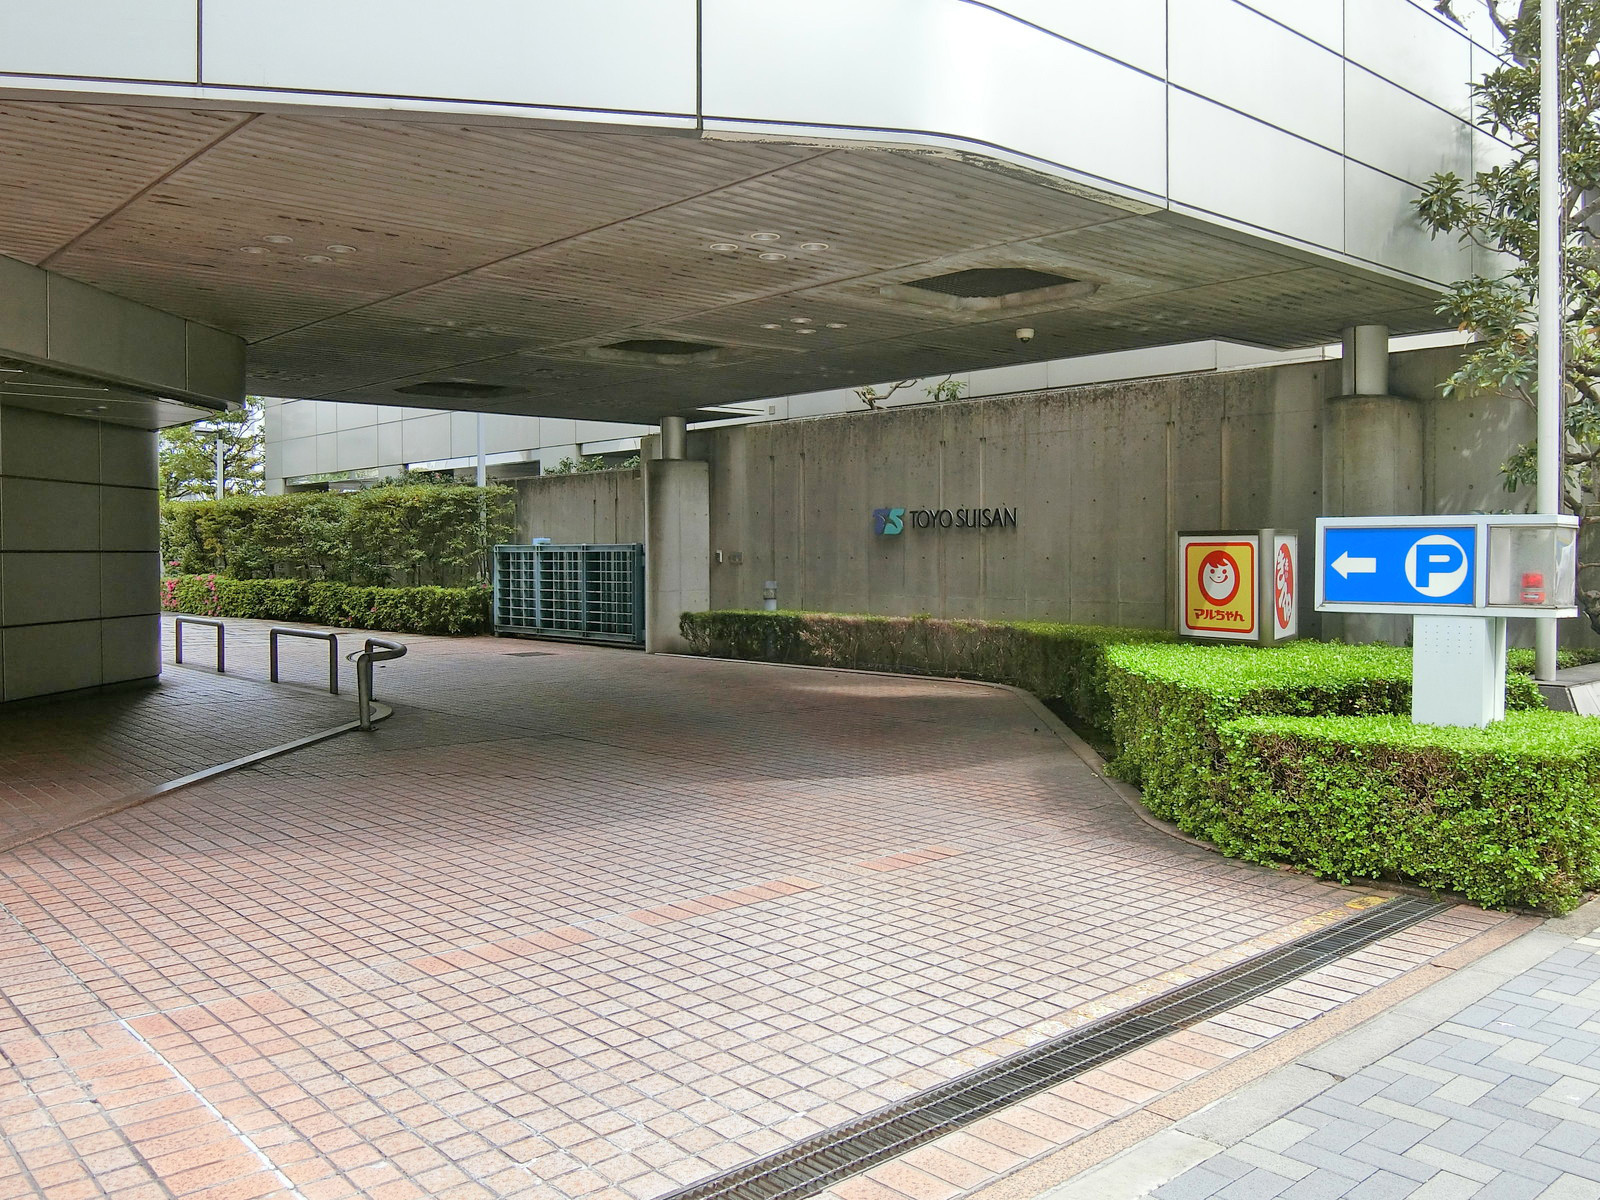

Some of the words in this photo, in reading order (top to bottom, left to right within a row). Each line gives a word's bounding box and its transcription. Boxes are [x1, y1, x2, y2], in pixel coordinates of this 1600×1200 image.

[910, 510, 953, 528] TOYO
[956, 507, 1018, 528] SUISAN
[1416, 544, 1463, 588] P
[1193, 608, 1245, 622] マルちゃん
